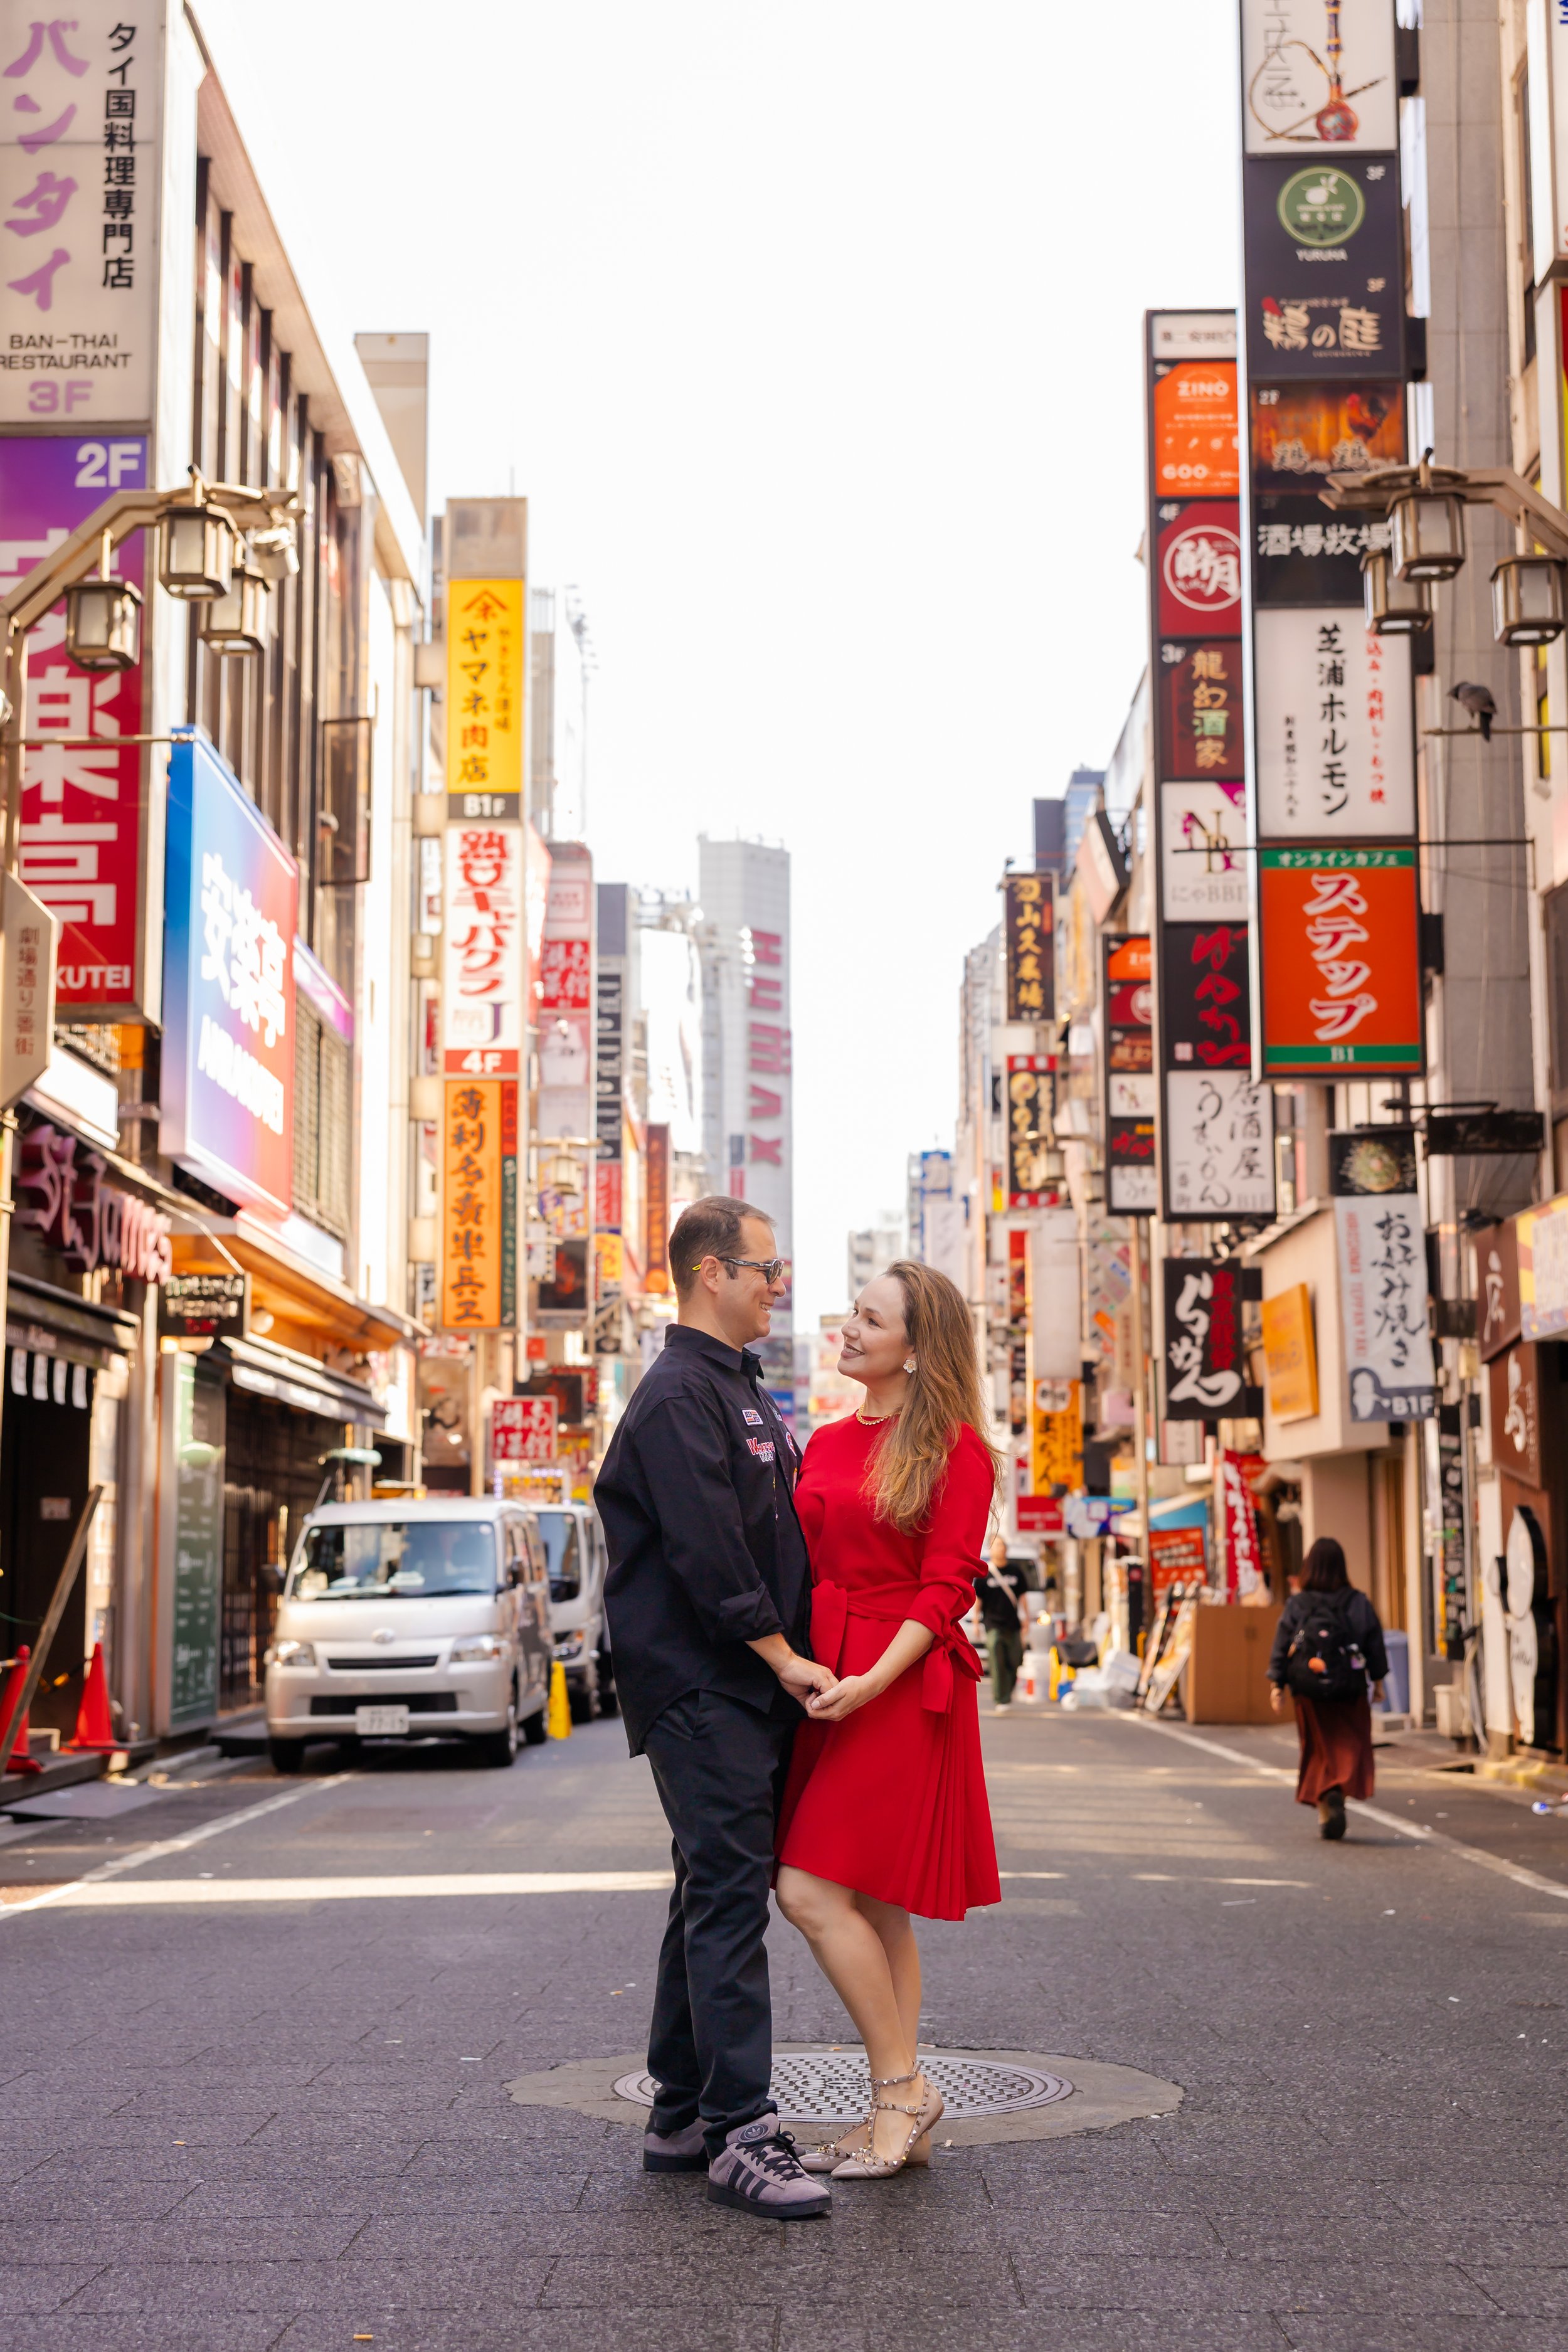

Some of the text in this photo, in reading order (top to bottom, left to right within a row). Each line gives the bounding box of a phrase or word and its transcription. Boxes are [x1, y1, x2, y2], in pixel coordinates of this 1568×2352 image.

[3, 20, 90, 312] バンタイ
[103, 23, 137, 290] タイ国料理専門店
[10, 334, 117, 350] BAN-THAI
[29, 381, 93, 413] 3F
[75, 443, 141, 488] 2F
[459, 629, 489, 784] ヤマネ肉店
[1317, 623, 1348, 815] 芝浦ホルモン
[464, 795, 506, 817] B1F
[1278, 851, 1399, 867] オンラインカフェ
[1302, 872, 1379, 1042] ステップ
[461, 1050, 502, 1074] 4F
[1330, 1045, 1355, 1062] B1
[1369, 1209, 1425, 1369] お好み焼き
[1391, 1396, 1434, 1416] B1F
